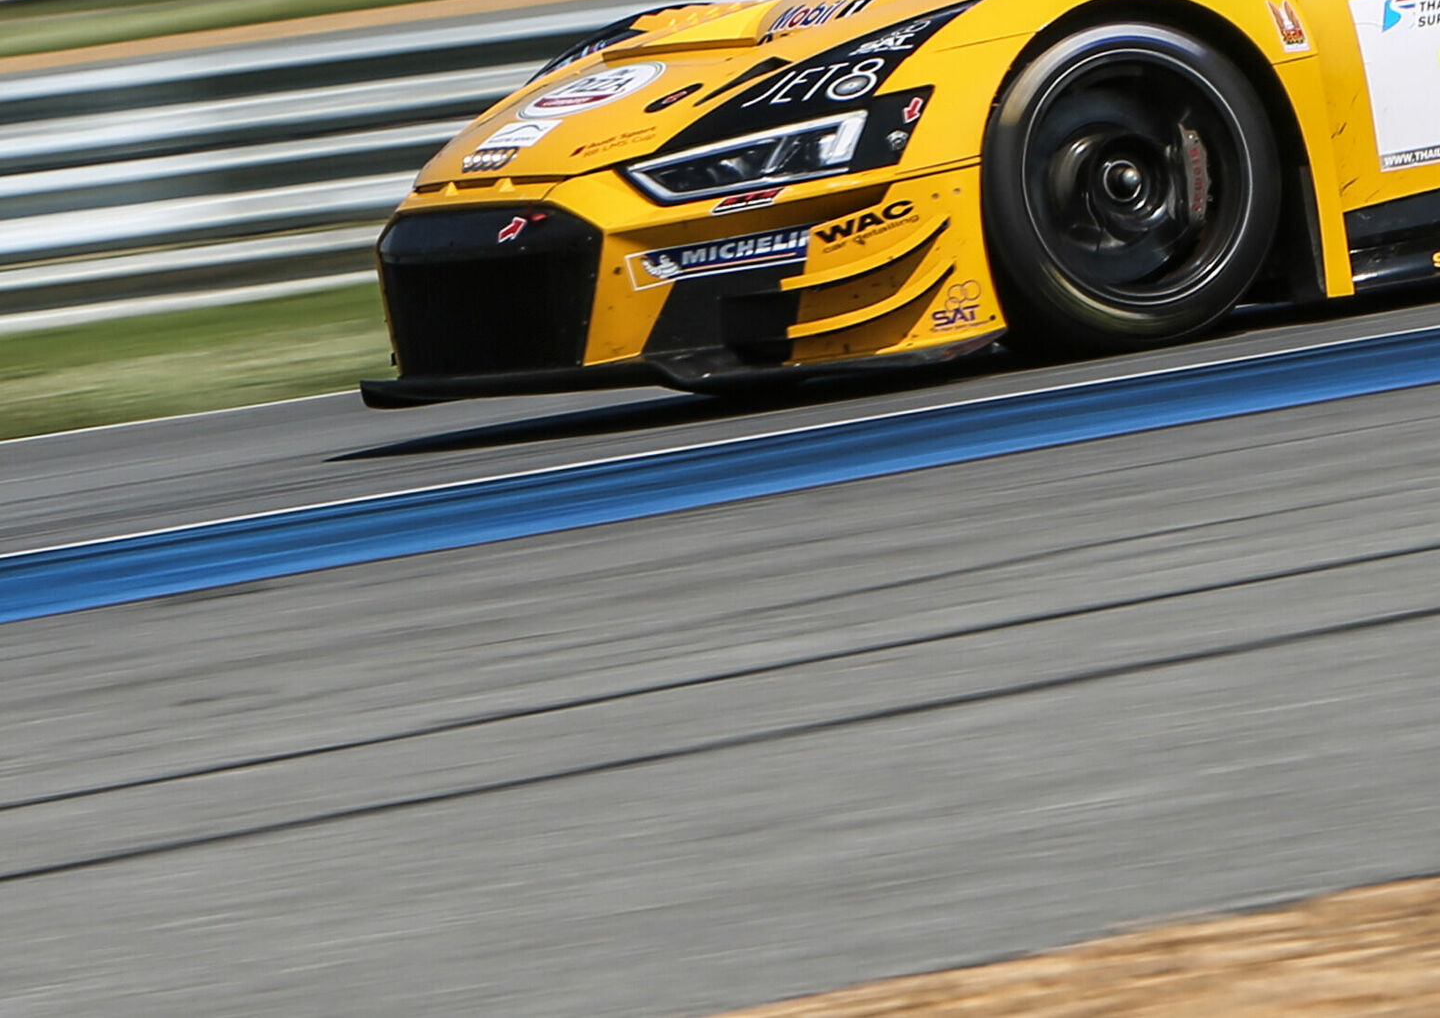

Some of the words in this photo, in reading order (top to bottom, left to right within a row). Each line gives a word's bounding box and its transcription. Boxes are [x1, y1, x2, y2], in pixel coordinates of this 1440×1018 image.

[769, 0, 847, 31] Mobil
[741, 58, 885, 108] JET8
[815, 200, 914, 244] WAC
[931, 304, 980, 328] SAT
